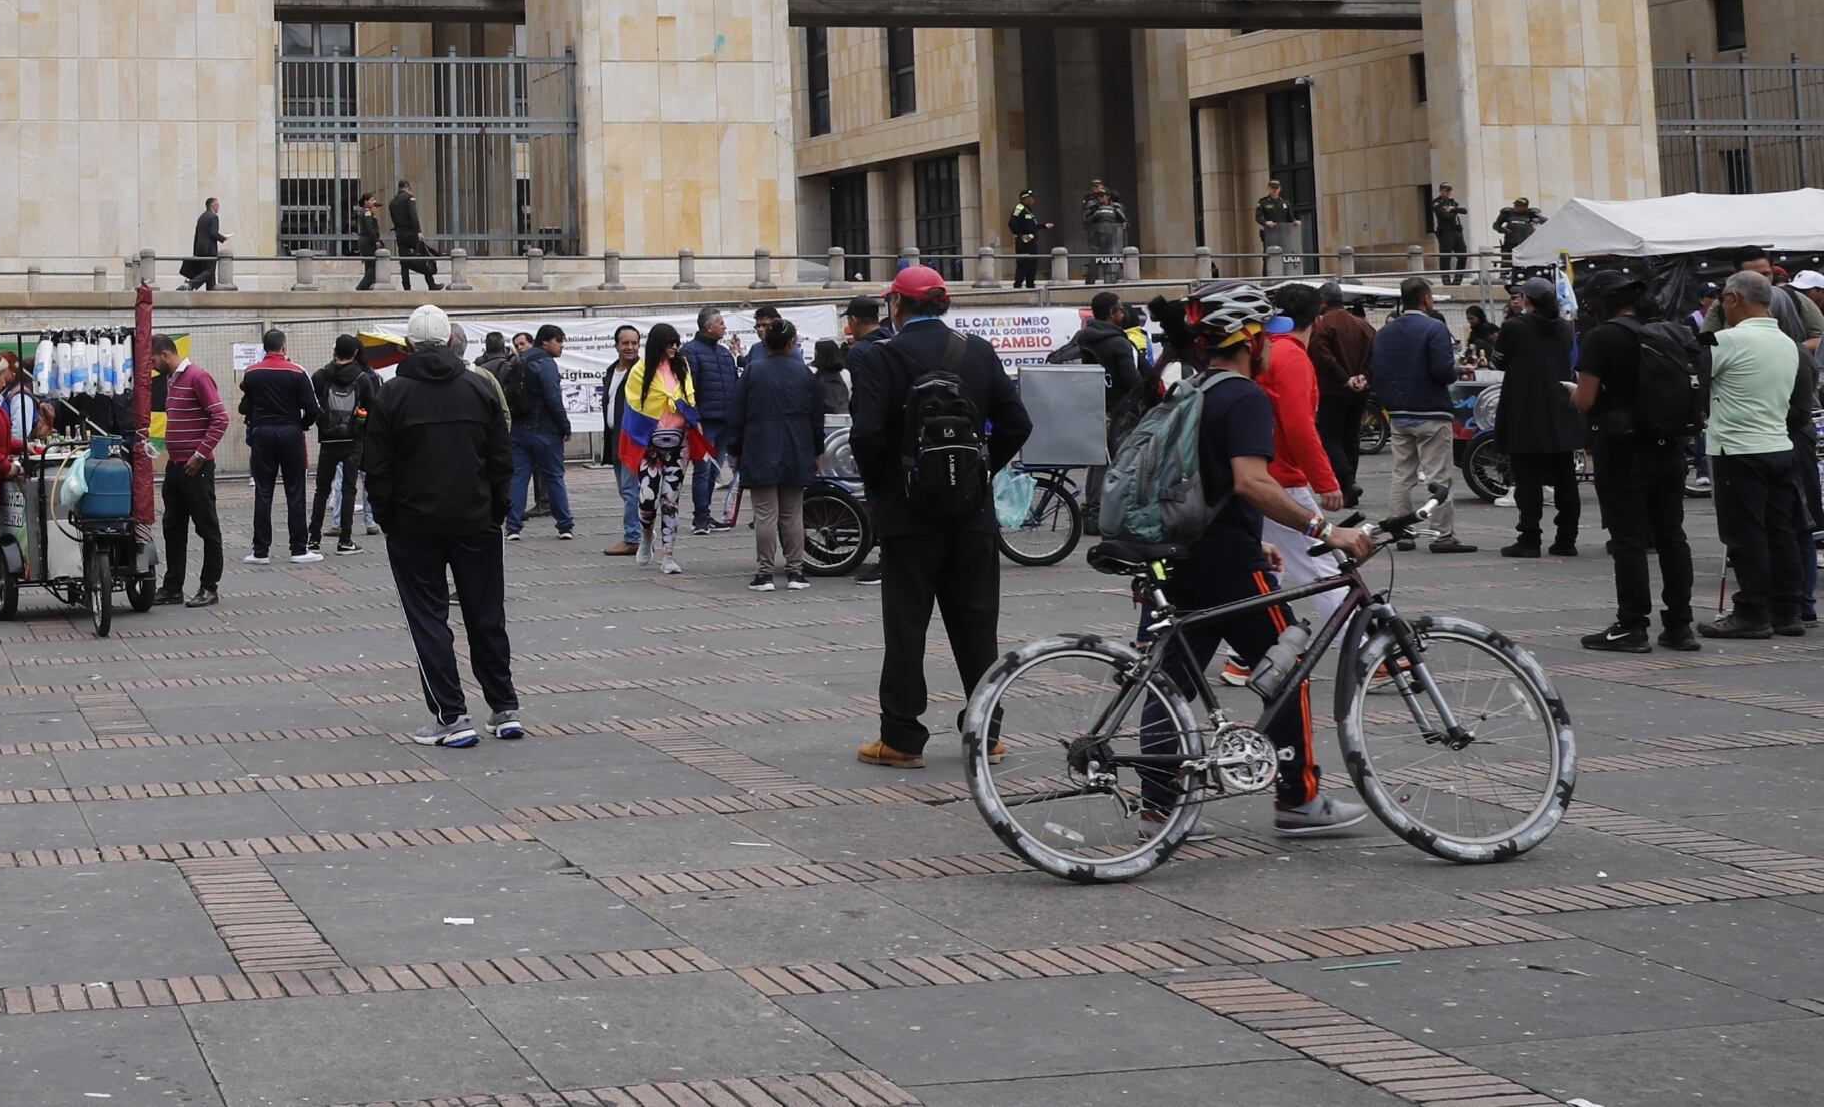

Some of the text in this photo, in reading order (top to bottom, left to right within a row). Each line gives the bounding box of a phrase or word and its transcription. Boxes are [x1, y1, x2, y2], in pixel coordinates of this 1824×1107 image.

[955, 316, 1050, 328] EL CATATUMBO
[1002, 327, 1051, 335] GOBIERNO
[990, 335, 1053, 349] CAMBIO
[1016, 357, 1045, 366] PETR
